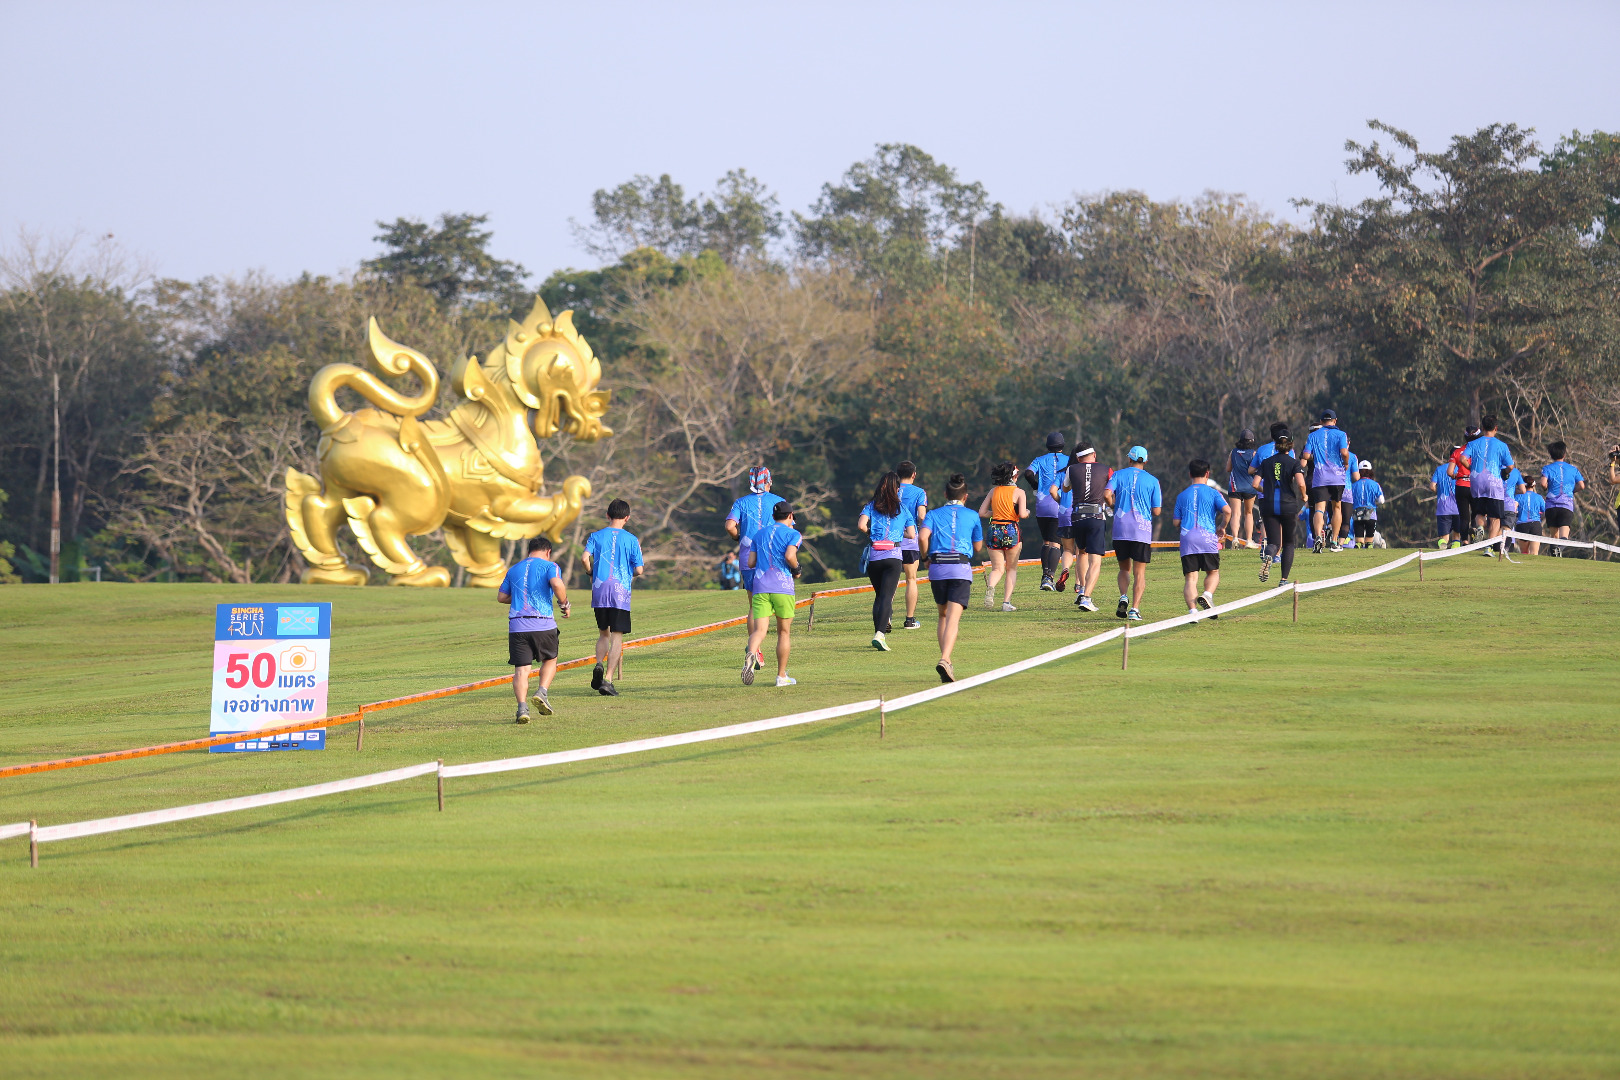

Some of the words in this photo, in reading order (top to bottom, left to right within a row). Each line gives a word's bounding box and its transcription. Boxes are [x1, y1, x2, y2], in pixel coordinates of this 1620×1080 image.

[230, 613, 265, 621] SERIES
[225, 652, 277, 689] 50
[278, 675, 316, 688] เมตร
[223, 693, 315, 713] เจอช่างภาพ
